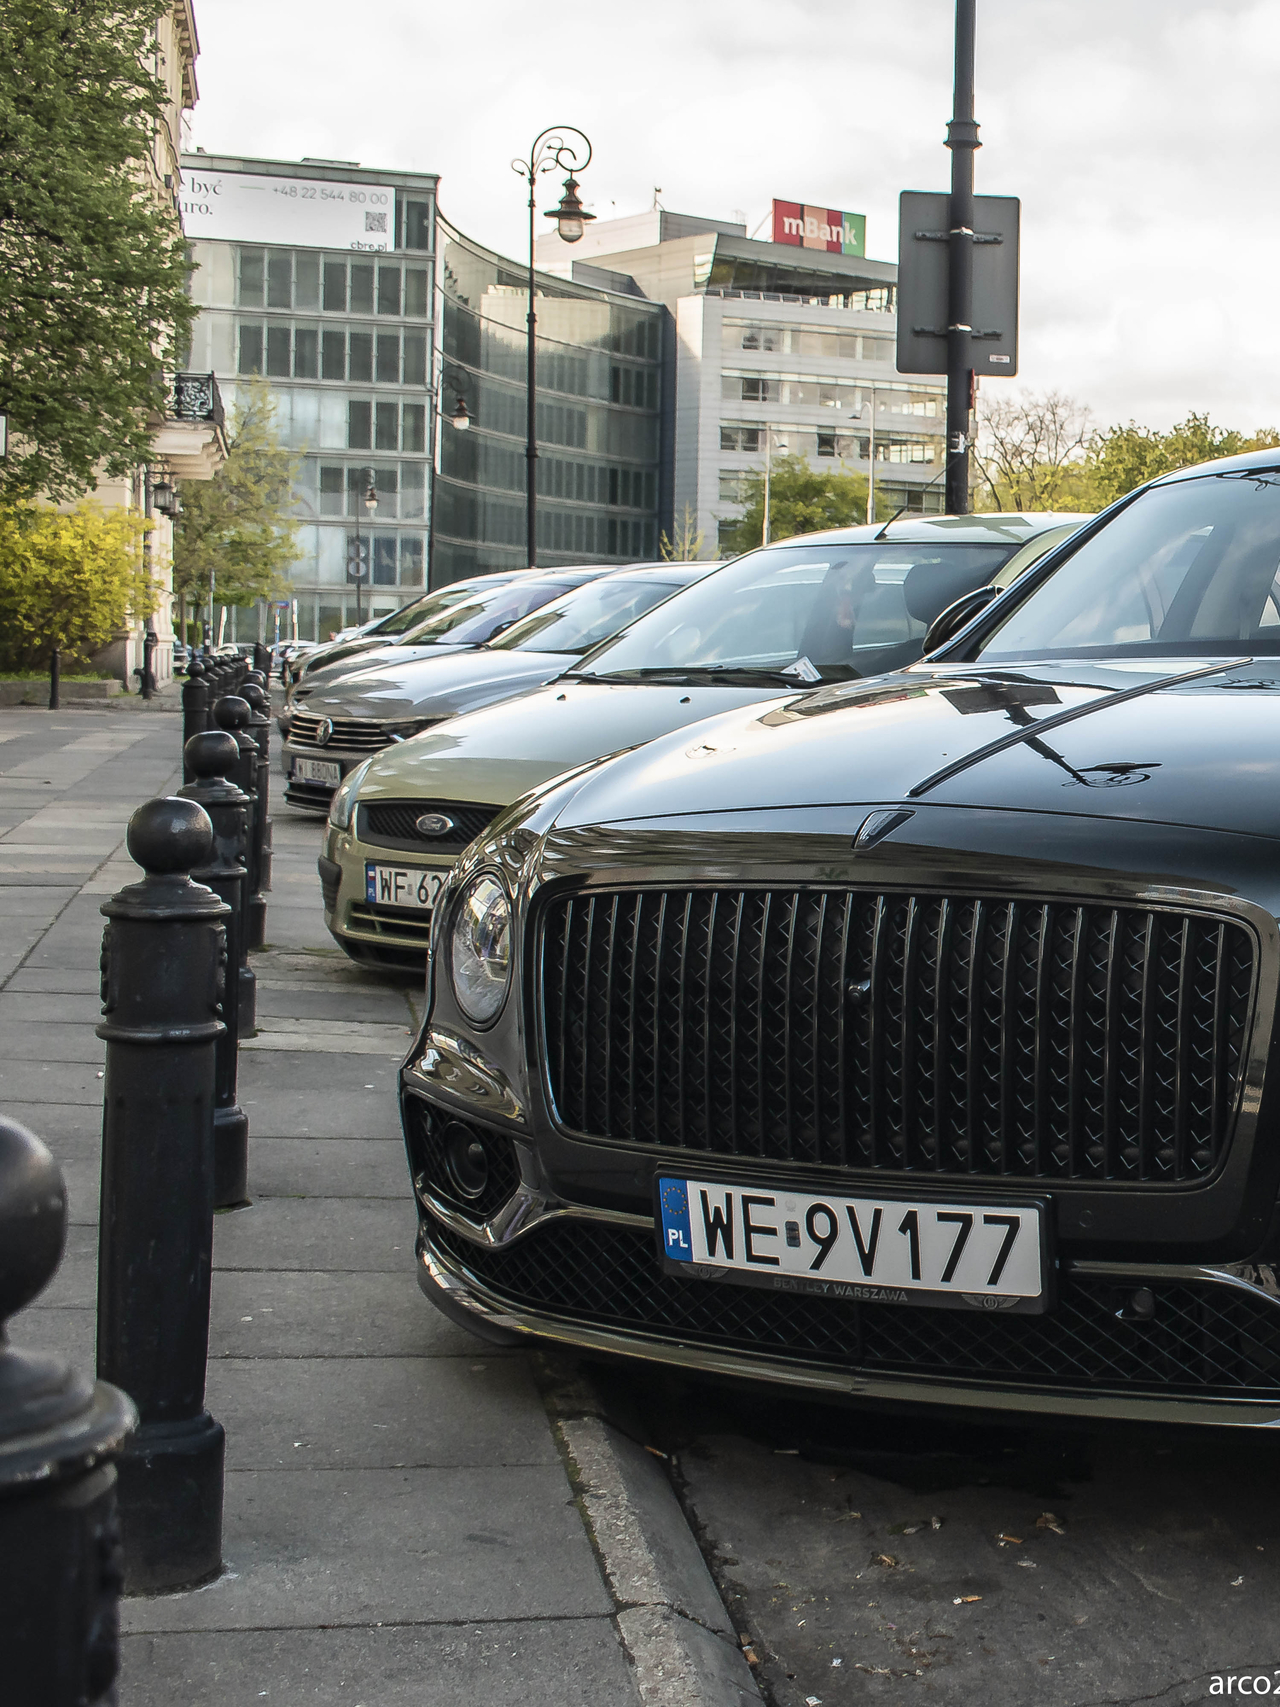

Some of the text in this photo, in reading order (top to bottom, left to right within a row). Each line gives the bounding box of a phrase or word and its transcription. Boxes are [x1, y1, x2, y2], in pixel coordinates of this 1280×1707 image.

[191, 176, 222, 198] być
[272, 186, 388, 205] +48 22 544 80 00
[783, 216, 857, 245] mBank
[350, 240, 388, 252] cbre.pl
[380, 870, 408, 902] WF
[668, 1229, 688, 1248] PL
[700, 1189, 1021, 1286] WE 9V177
[834, 1284, 908, 1302] WARSZAWA
